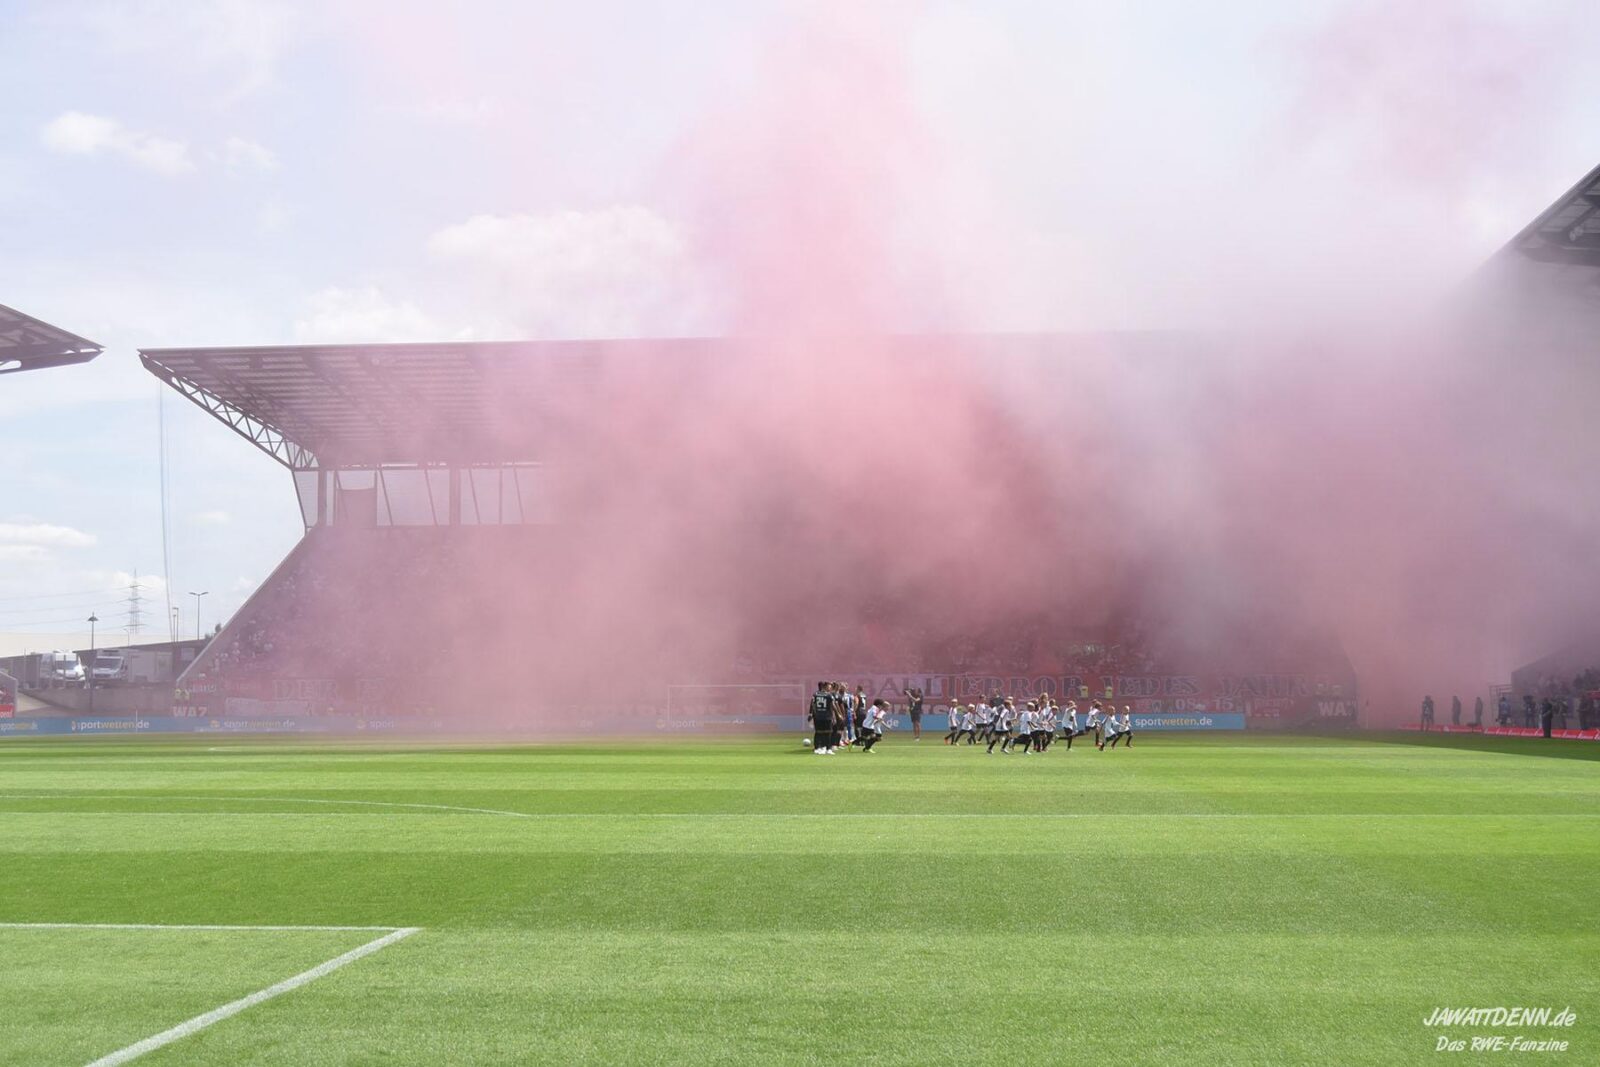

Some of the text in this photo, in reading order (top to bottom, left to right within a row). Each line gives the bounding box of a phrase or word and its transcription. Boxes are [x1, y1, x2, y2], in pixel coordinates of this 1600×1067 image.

[815, 696, 828, 709] 24
[76, 719, 150, 732] sportwetten.de
[1135, 716, 1213, 728] sportwetten.de
